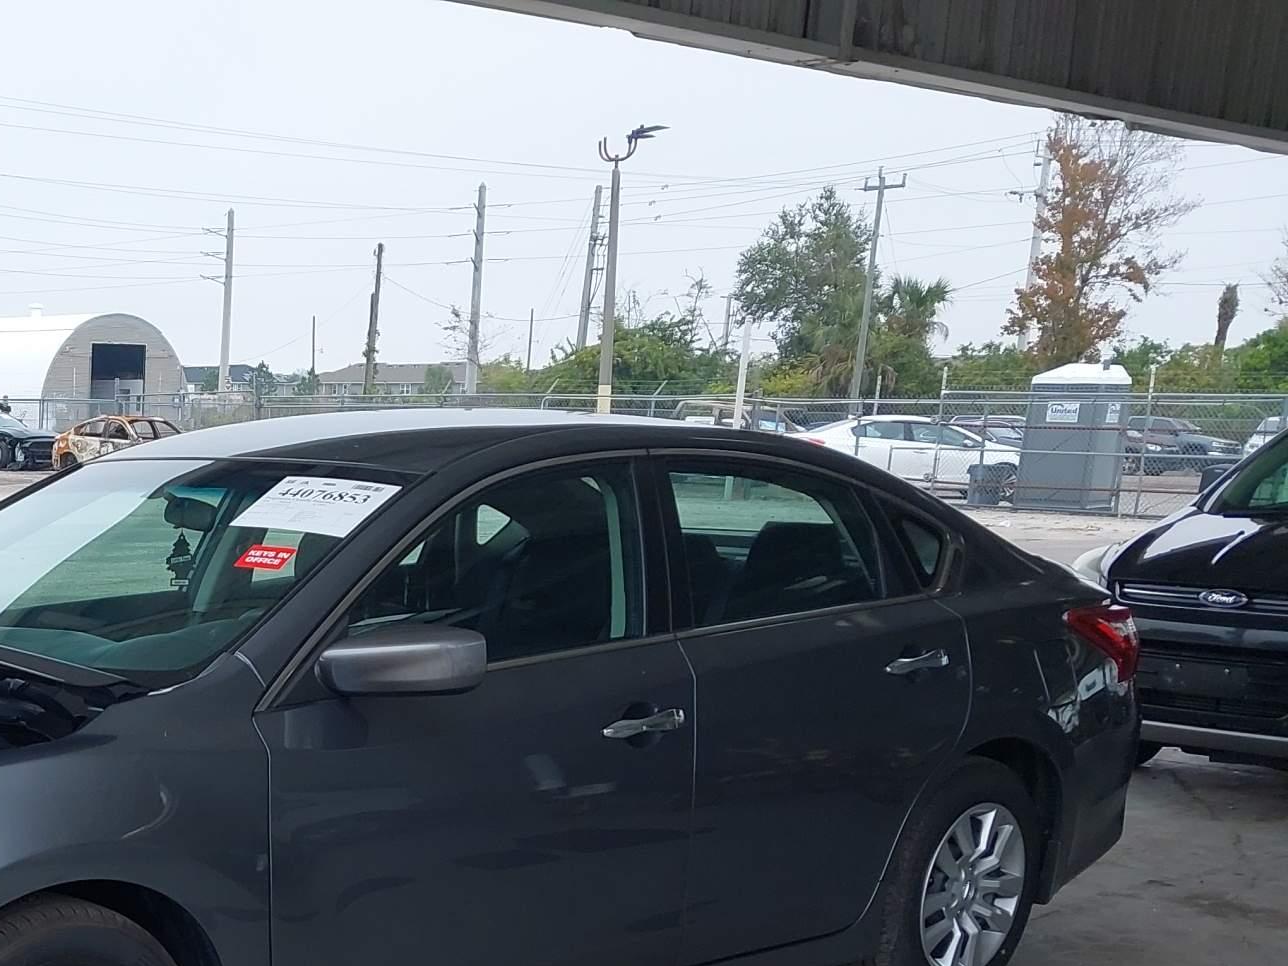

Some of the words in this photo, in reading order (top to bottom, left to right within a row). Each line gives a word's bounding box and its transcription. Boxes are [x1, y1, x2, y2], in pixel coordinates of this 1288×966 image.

[278, 487, 371, 504] 44076853
[247, 549, 277, 558] KEYS
[276, 551, 292, 559] IN
[244, 555, 282, 566] OFFICE
[1208, 592, 1236, 604] Ford
